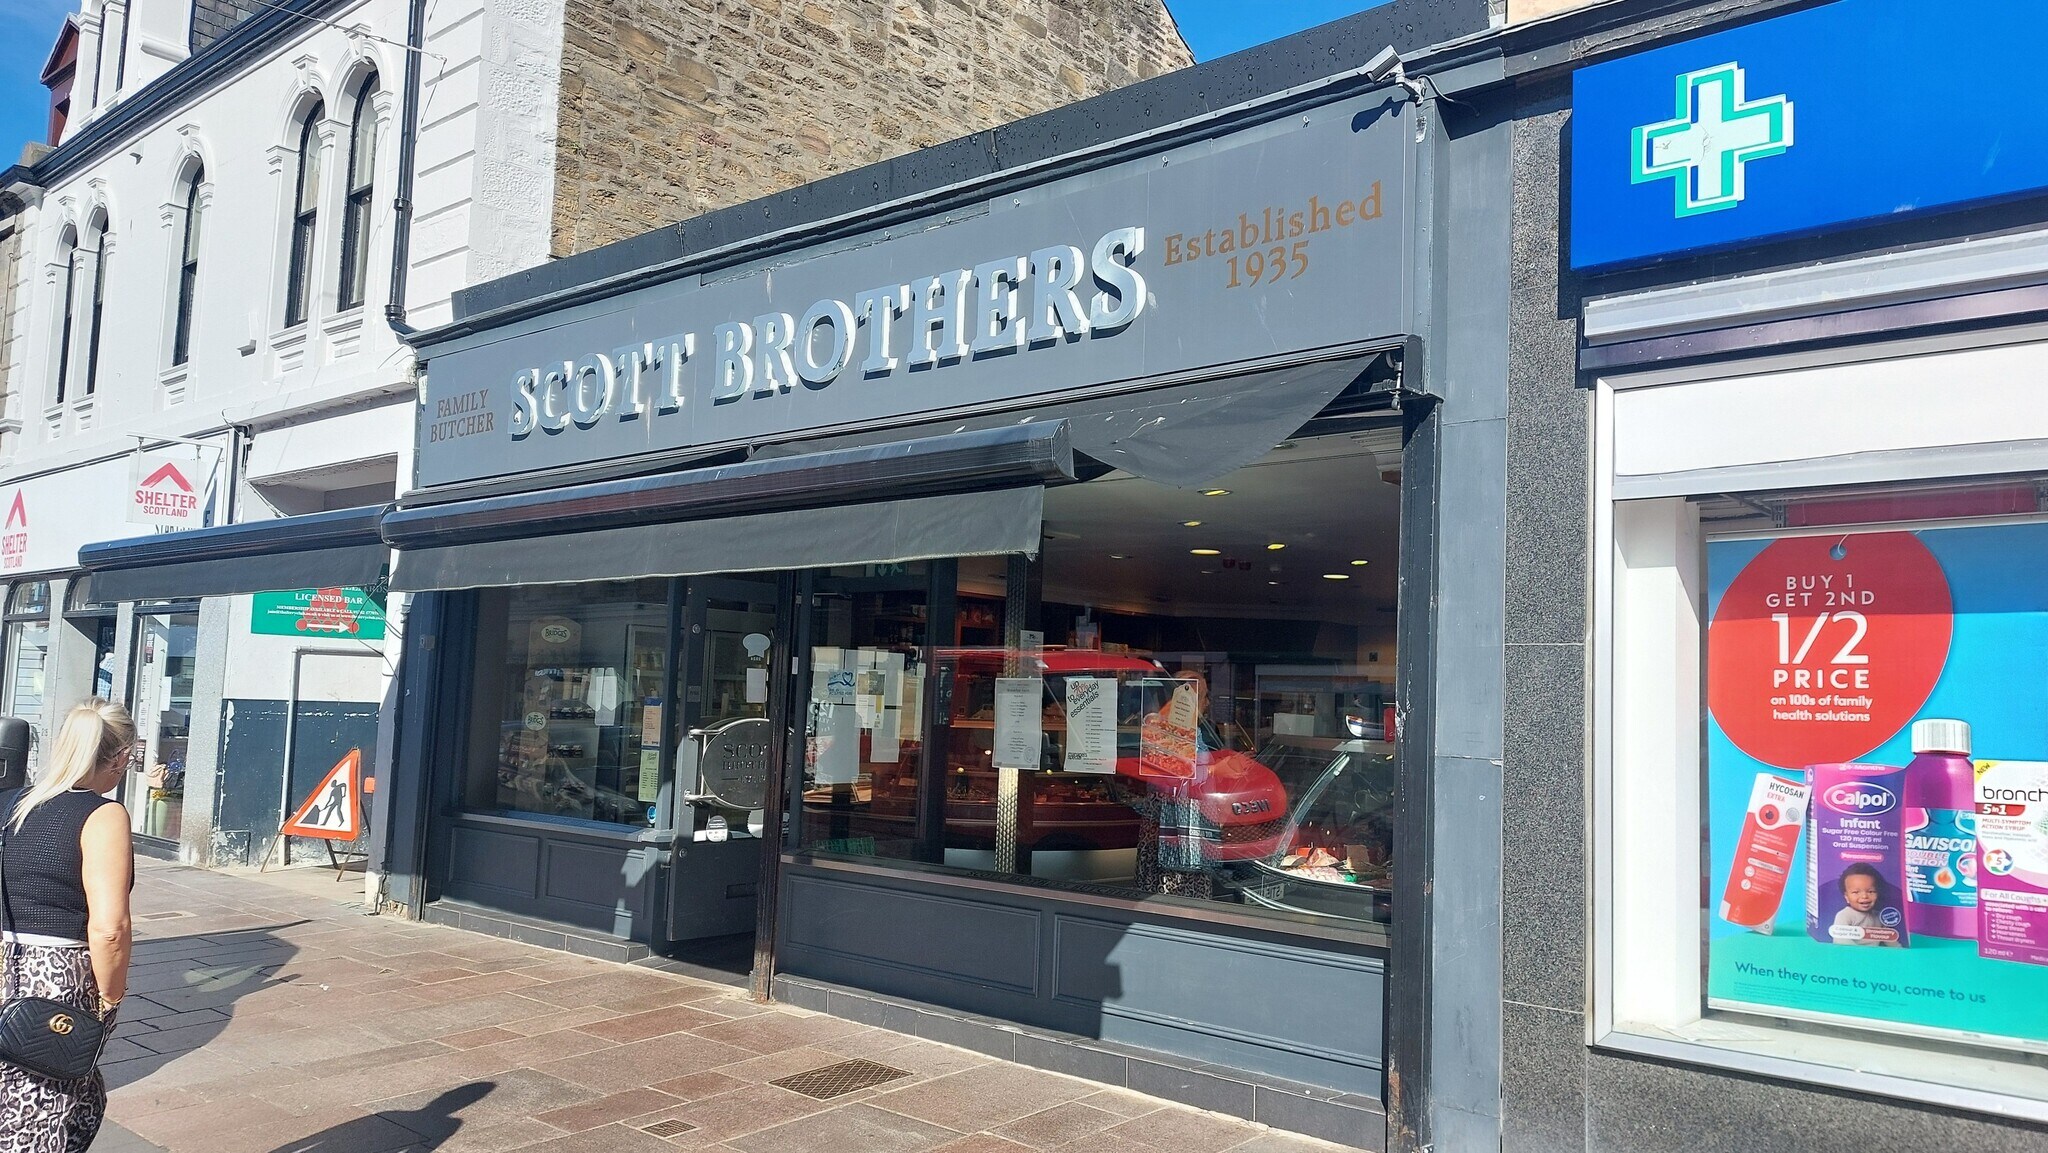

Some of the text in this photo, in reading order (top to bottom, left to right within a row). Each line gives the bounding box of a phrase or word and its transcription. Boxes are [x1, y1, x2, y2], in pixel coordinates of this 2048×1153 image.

[1163, 179, 1384, 267] Established
[1226, 240, 1309, 290] 1935
[507, 225, 1147, 437] SCOTT BROTHERS
[436, 388, 489, 420] FAMILY
[429, 412, 494, 444] BUTCHER
[135, 490, 197, 509] SHELTER
[143, 505, 188, 518] SCOTLAND
[2, 532, 27, 556] SHELTER
[4, 555, 23, 569] SCOTLAND
[1786, 574, 1853, 590] BUY 1
[295, 592, 363, 605] LICENSED BAR
[1766, 590, 1875, 608] GET 2ND
[1771, 611, 1869, 665] 1/2
[1070, 681, 1080, 690] up
[1773, 669, 1870, 689] PRICE
[1067, 680, 1100, 705] to everyday
[1070, 691, 1100, 718] essentials
[1770, 694, 1873, 709] on 100s of family
[1773, 709, 1870, 722] health solutions
[1977, 762, 1991, 776] NEW
[1766, 791, 1786, 803] EXTRA
[1768, 782, 1805, 799] HYCOSAN
[1831, 789, 1887, 809] Calpol
[1821, 827, 1843, 836] Sugar
[1843, 828, 1860, 836] Free
[1840, 817, 1881, 830] Infant
[1832, 841, 1889, 850] Oral Suspension
[1905, 833, 1977, 852] GAVISCO
[1996, 857, 2003, 866] 5
[1984, 890, 1998, 899] For
[1999, 892, 2010, 900] All
[2010, 893, 2042, 904] Coughs
[1984, 947, 1997, 955] 120
[1735, 961, 1774, 977] When
[1778, 966, 1808, 985] they
[1811, 974, 1849, 988] come
[1852, 977, 1868, 990] to
[1871, 980, 1901, 996] you,
[1904, 984, 1946, 999] come
[1949, 988, 1966, 1001] to
[1969, 992, 1986, 1004] us
